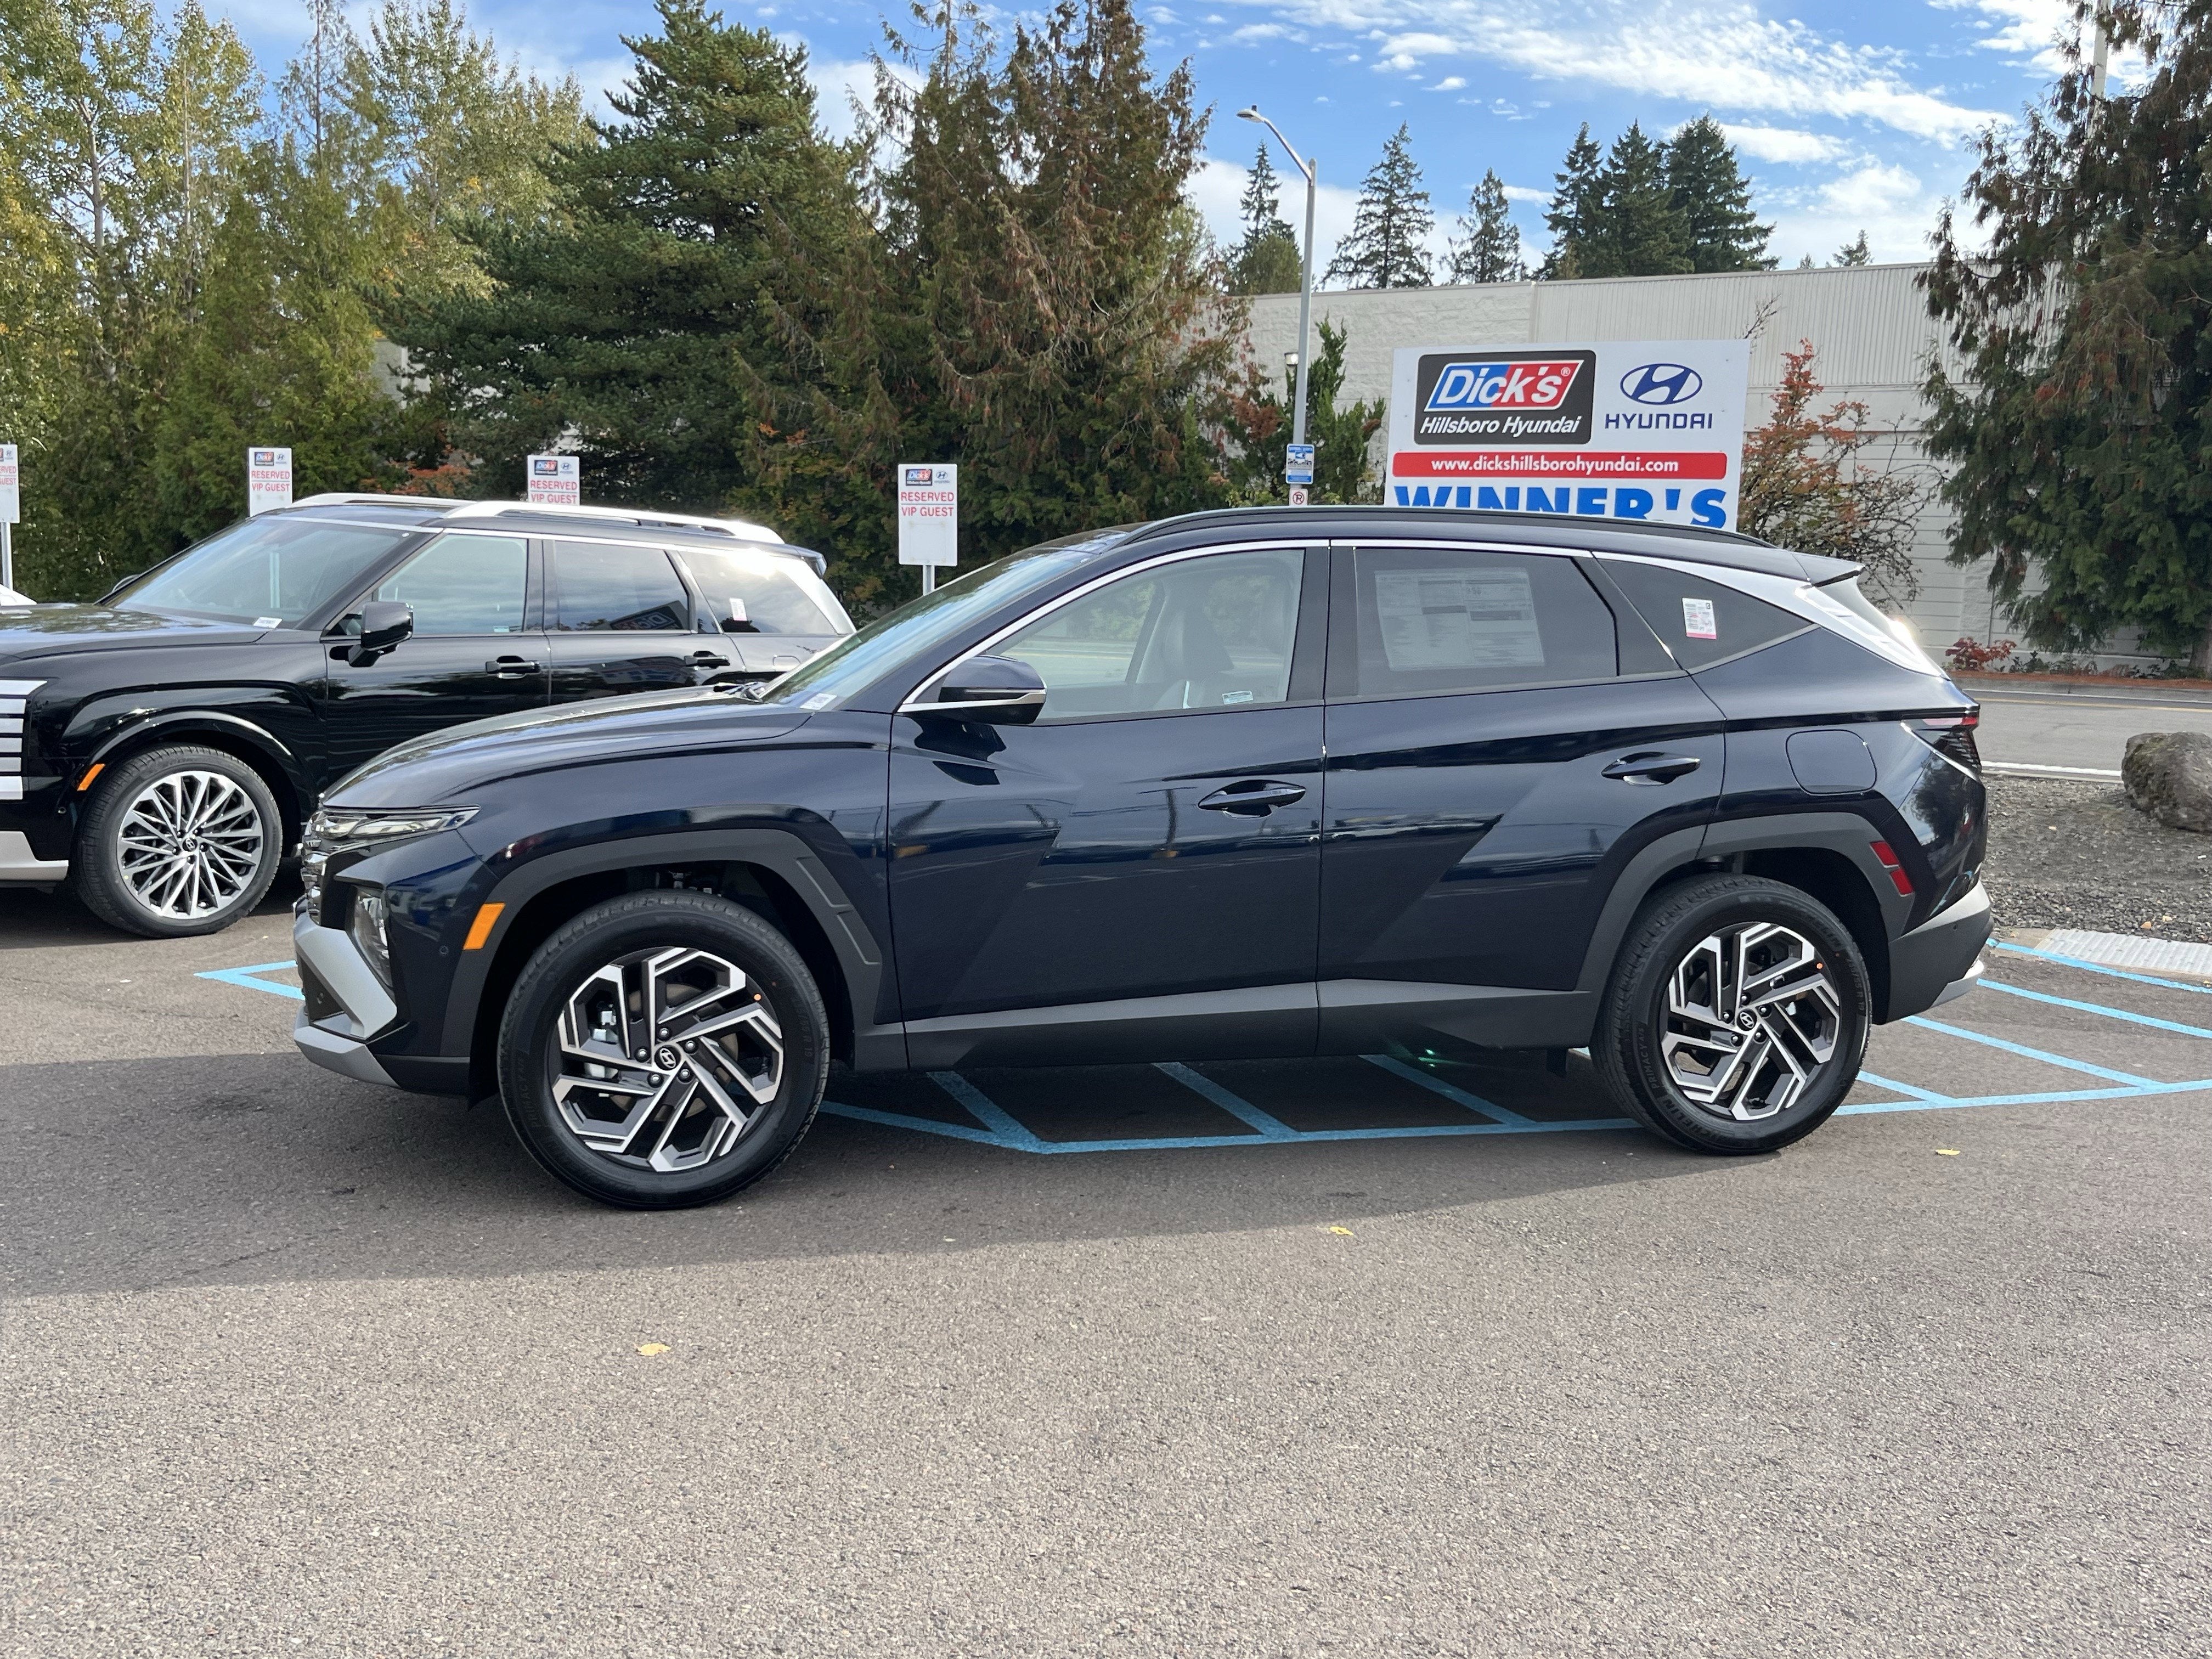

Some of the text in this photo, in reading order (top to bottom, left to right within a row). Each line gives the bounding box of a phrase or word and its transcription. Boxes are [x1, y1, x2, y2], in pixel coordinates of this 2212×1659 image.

[1436, 366, 1562, 404] Dick's
[1605, 413, 1713, 429] HYUNDAI
[1420, 416, 1582, 438] Hillsboro Hyundai
[1431, 455, 1679, 475] www.dickshillsborohyundai.com
[251, 470, 290, 479] RESERVED
[265, 483, 290, 492] GUEST
[530, 480, 577, 490] RESERVED
[531, 493, 577, 504] VIP GUEST
[901, 492, 954, 501] RESERVED
[901, 506, 953, 516] VIP GUEST
[1639, 1043, 1660, 1089] PRIMACY
